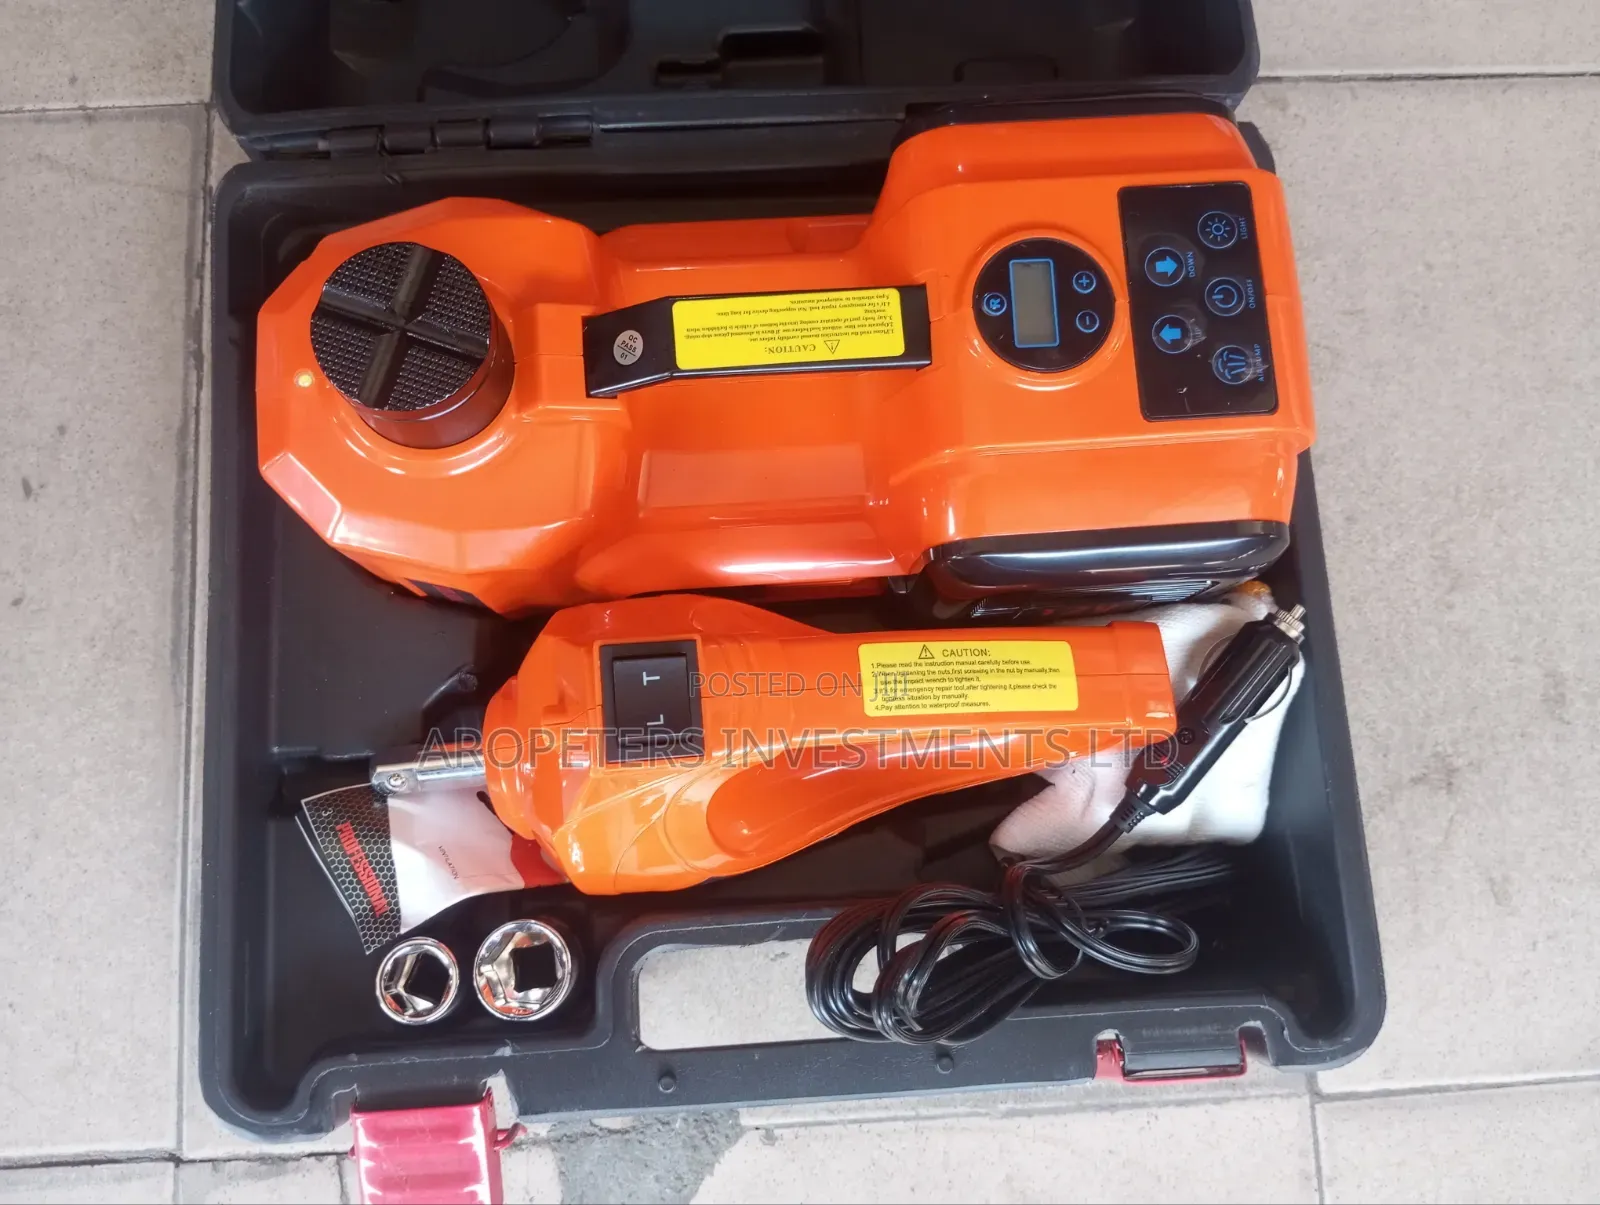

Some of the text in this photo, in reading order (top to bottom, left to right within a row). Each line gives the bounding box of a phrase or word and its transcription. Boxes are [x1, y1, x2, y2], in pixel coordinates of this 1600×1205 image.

[1239, 217, 1248, 240] LIGHT
[1186, 251, 1196, 278] DOWN
[1246, 280, 1256, 309] ON/OFF
[620, 340, 638, 353] PASS
[628, 334, 638, 344] QC
[764, 344, 816, 354] CAUTION:
[942, 648, 990, 658] CAUTION:
[642, 671, 664, 726] L T
[929, 701, 960, 709] waterproof
[336, 819, 390, 918] PROFESSIONAL
